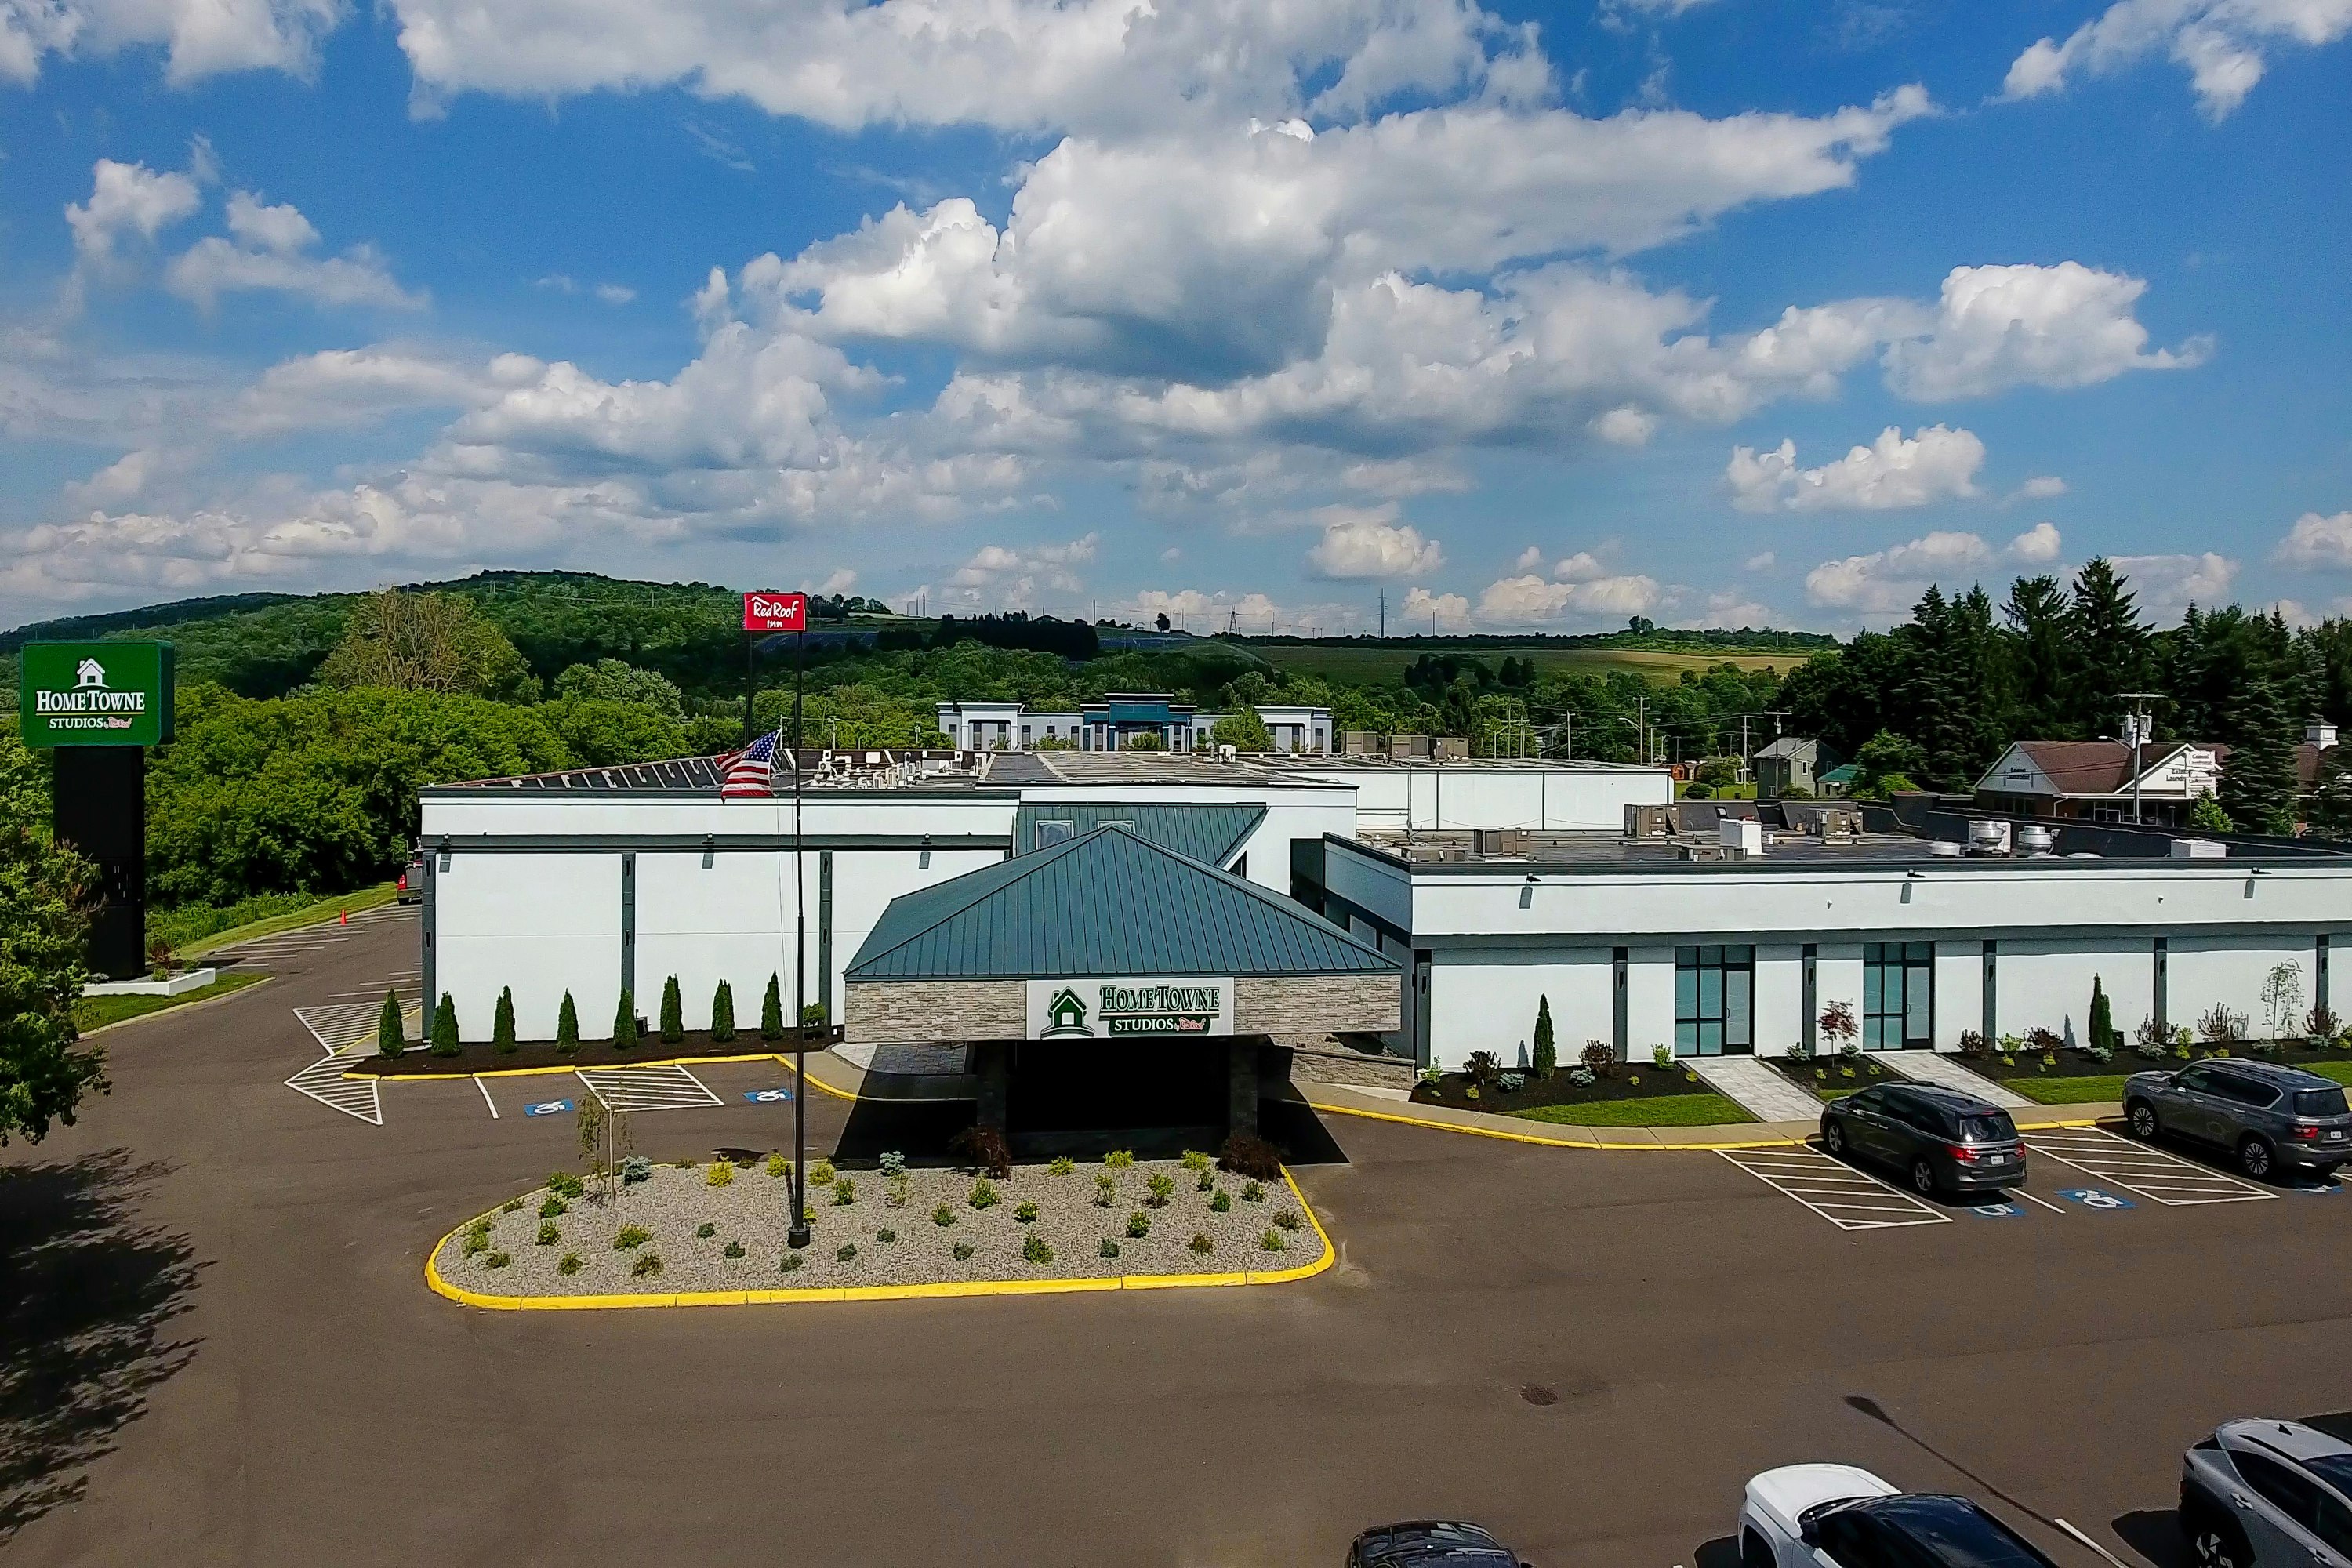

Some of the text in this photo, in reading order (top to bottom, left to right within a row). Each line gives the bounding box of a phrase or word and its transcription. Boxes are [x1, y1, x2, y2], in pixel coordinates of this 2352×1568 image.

[773, 601, 799, 619] Roof
[49, 717, 103, 728] STUDIOS
[1114, 1018, 1174, 1031] STUDIOS
